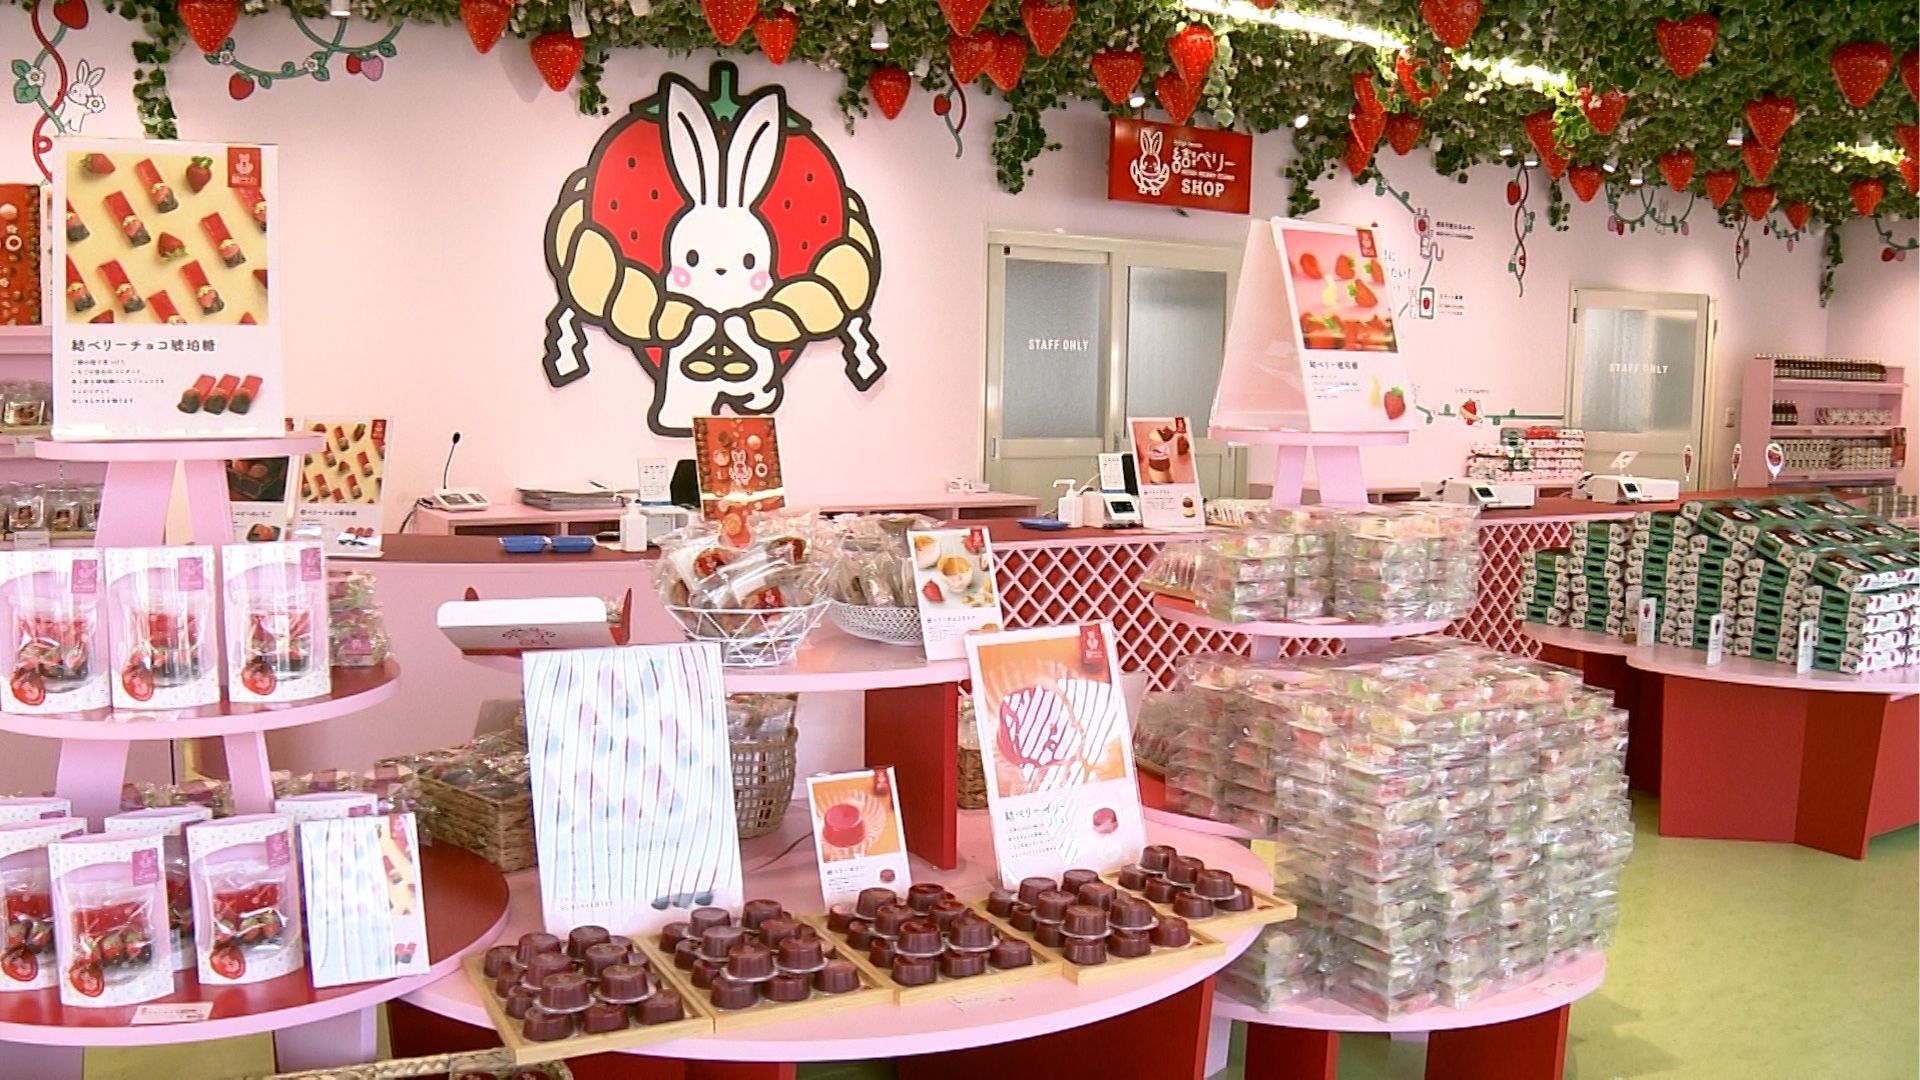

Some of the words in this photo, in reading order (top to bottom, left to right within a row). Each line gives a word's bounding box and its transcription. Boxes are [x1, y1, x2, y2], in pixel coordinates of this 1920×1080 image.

[1181, 178, 1225, 198] SHOP
[1028, 339, 1060, 350] STAFF
[1062, 339, 1089, 351] ONLY
